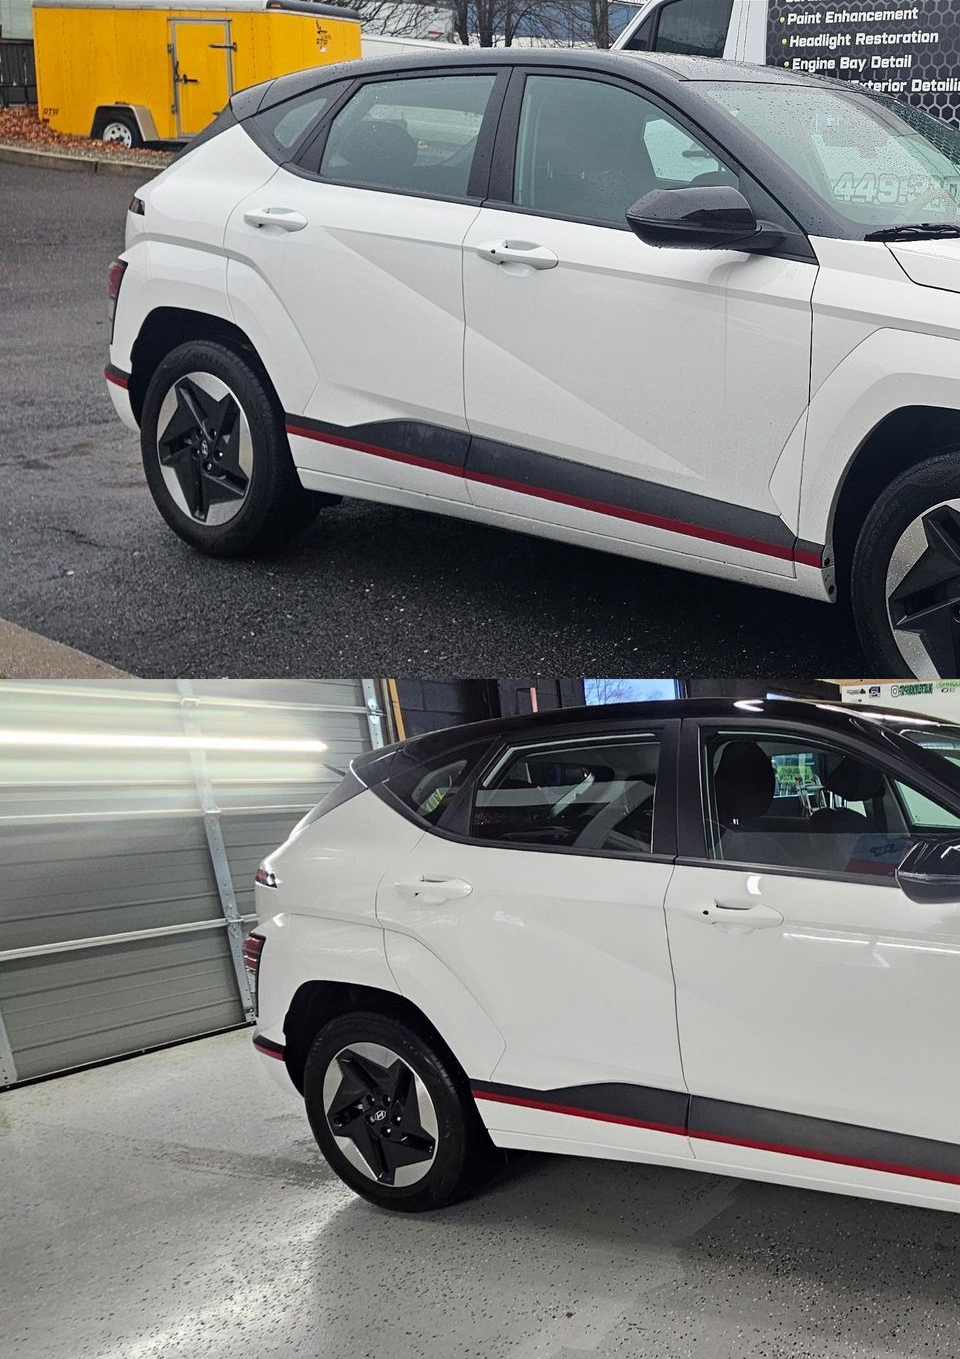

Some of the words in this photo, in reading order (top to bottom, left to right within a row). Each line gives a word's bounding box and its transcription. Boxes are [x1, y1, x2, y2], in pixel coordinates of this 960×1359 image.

[787, 12, 821, 25] Paint
[825, 7, 919, 23] Enhancement
[789, 33, 851, 49] Headlight
[855, 30, 939, 45] Restoration
[792, 57, 836, 72] Engine
[839, 57, 867, 72] Bay
[870, 54, 912, 69] Detail
